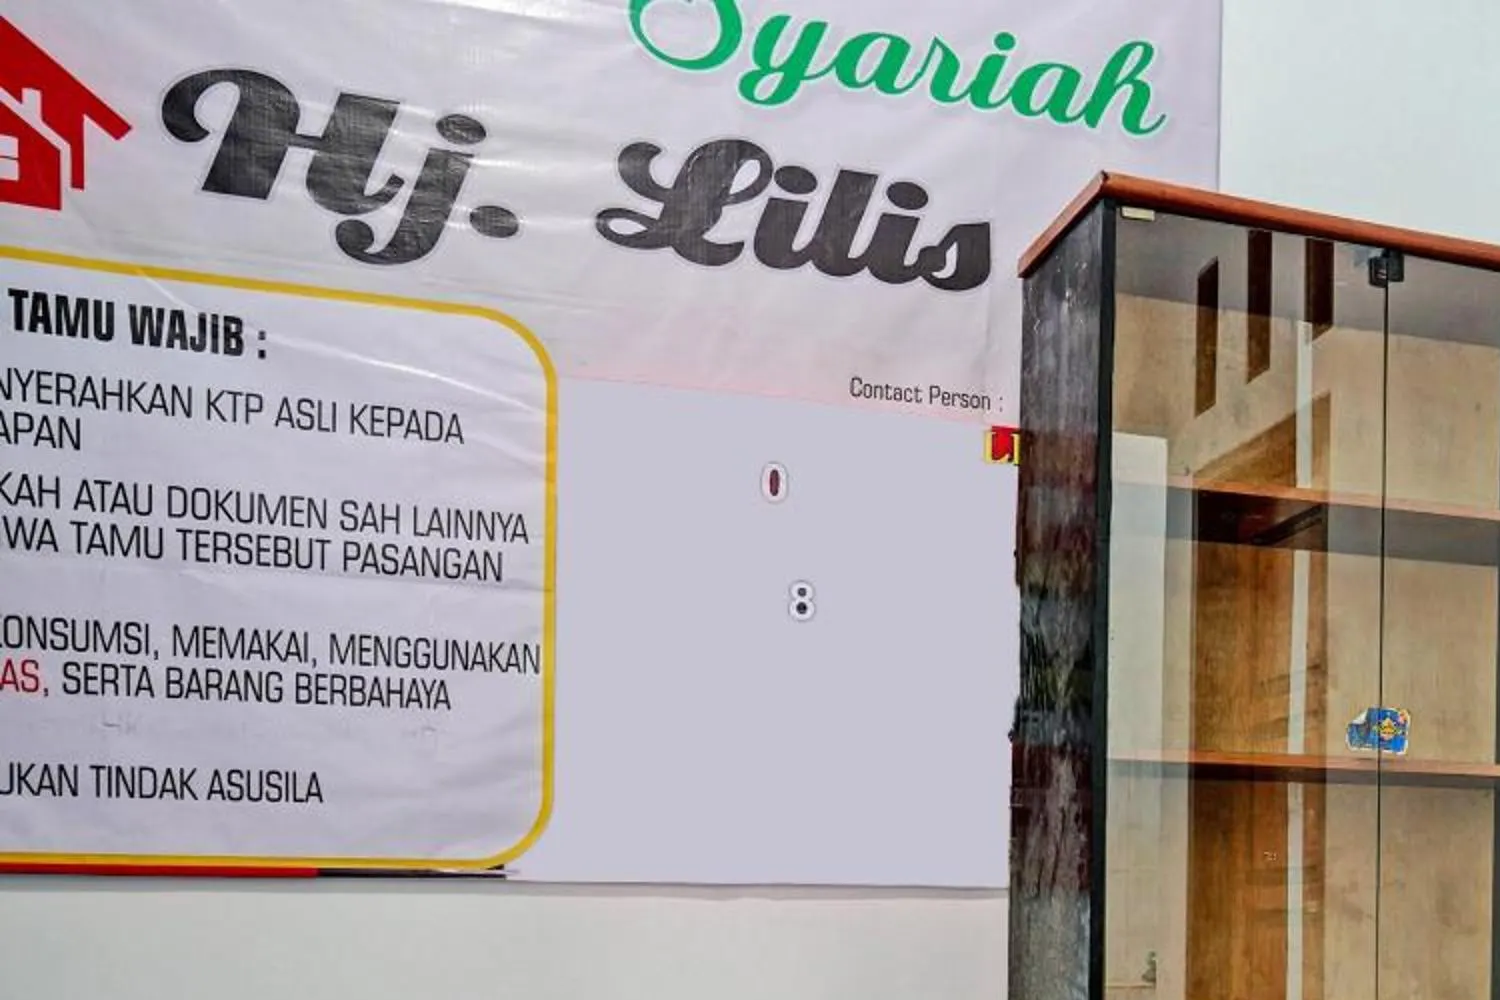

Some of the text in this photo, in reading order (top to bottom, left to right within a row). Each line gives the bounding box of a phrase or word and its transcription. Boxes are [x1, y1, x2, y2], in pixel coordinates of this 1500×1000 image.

[160, 67, 992, 292] Hj. Lilis
[8, 287, 115, 342] TAMU
[128, 303, 244, 357] WAJIB
[206, 387, 264, 425] KTP
[275, 396, 337, 433] ASLI
[350, 403, 465, 445] KEPADA
[849, 375, 923, 404] Contact
[929, 385, 991, 411] Person
[73, 480, 153, 517] ATAU
[167, 485, 327, 530] DOKUMEN
[339, 500, 401, 535] SAH
[413, 505, 530, 545] LAINNYA
[2, 515, 504, 582] WA TAMU TERSEBUT PASANGAN
[0, 614, 541, 675] ONSUMSI, MEMAKAI, MENGGUNAKAN
[62, 661, 155, 699] SERTA
[165, 667, 284, 704] BARANG
[294, 669, 452, 711] BERBAHAYA
[89, 765, 199, 801] TINDAK
[206, 769, 324, 804] ASUSILA
